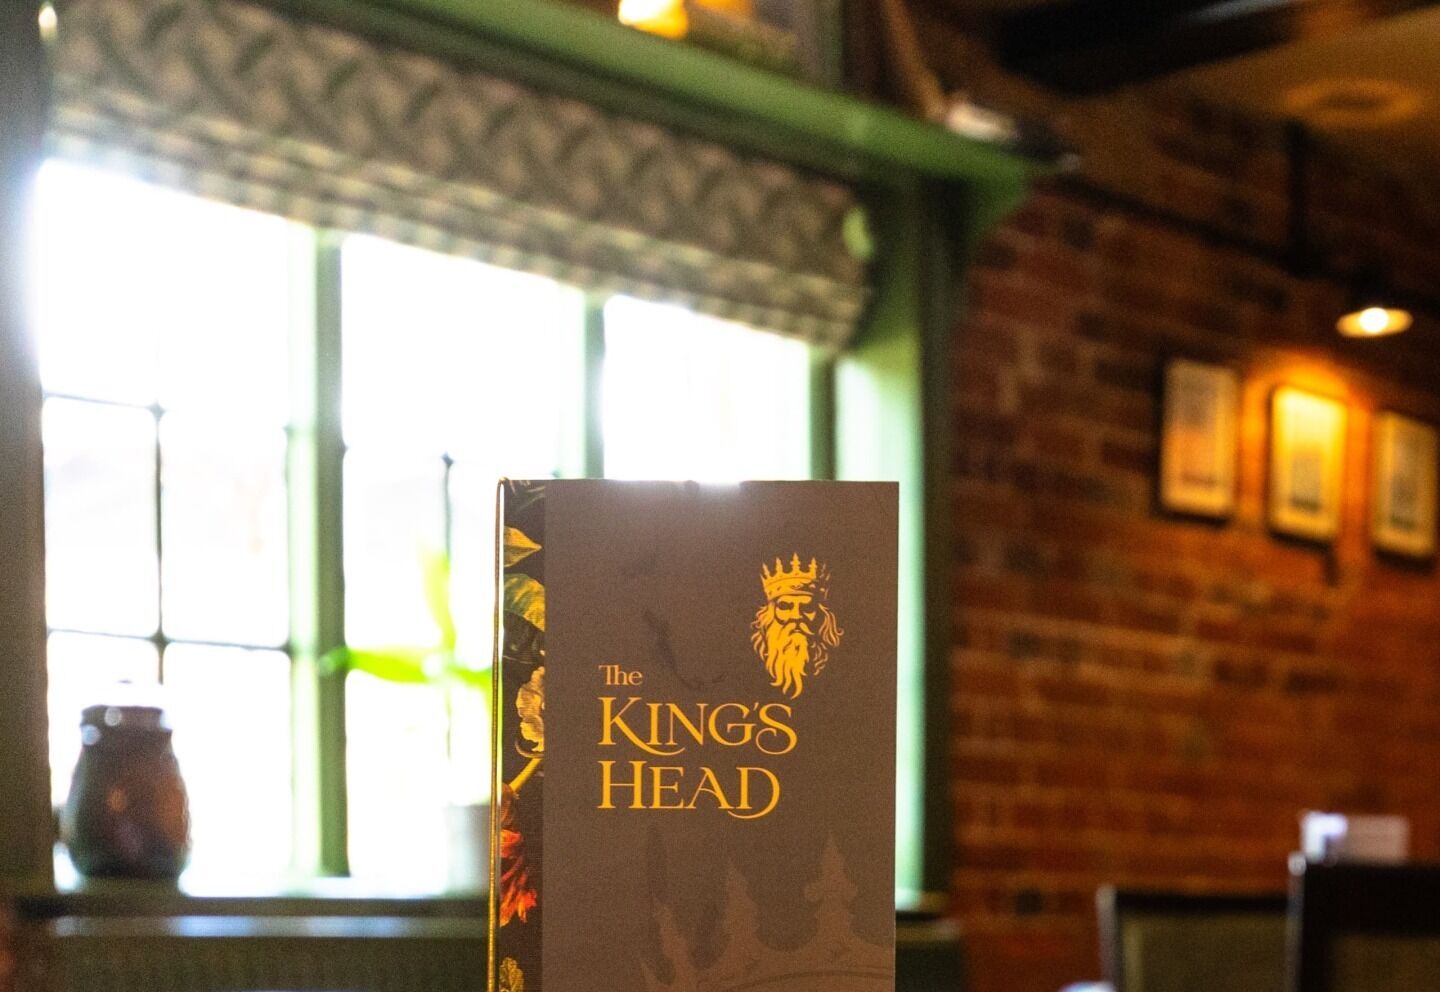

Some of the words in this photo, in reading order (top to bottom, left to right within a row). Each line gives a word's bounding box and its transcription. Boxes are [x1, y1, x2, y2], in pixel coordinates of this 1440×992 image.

[598, 664, 643, 687] The
[597, 696, 798, 757] KING'S
[597, 760, 781, 820] HEAD
